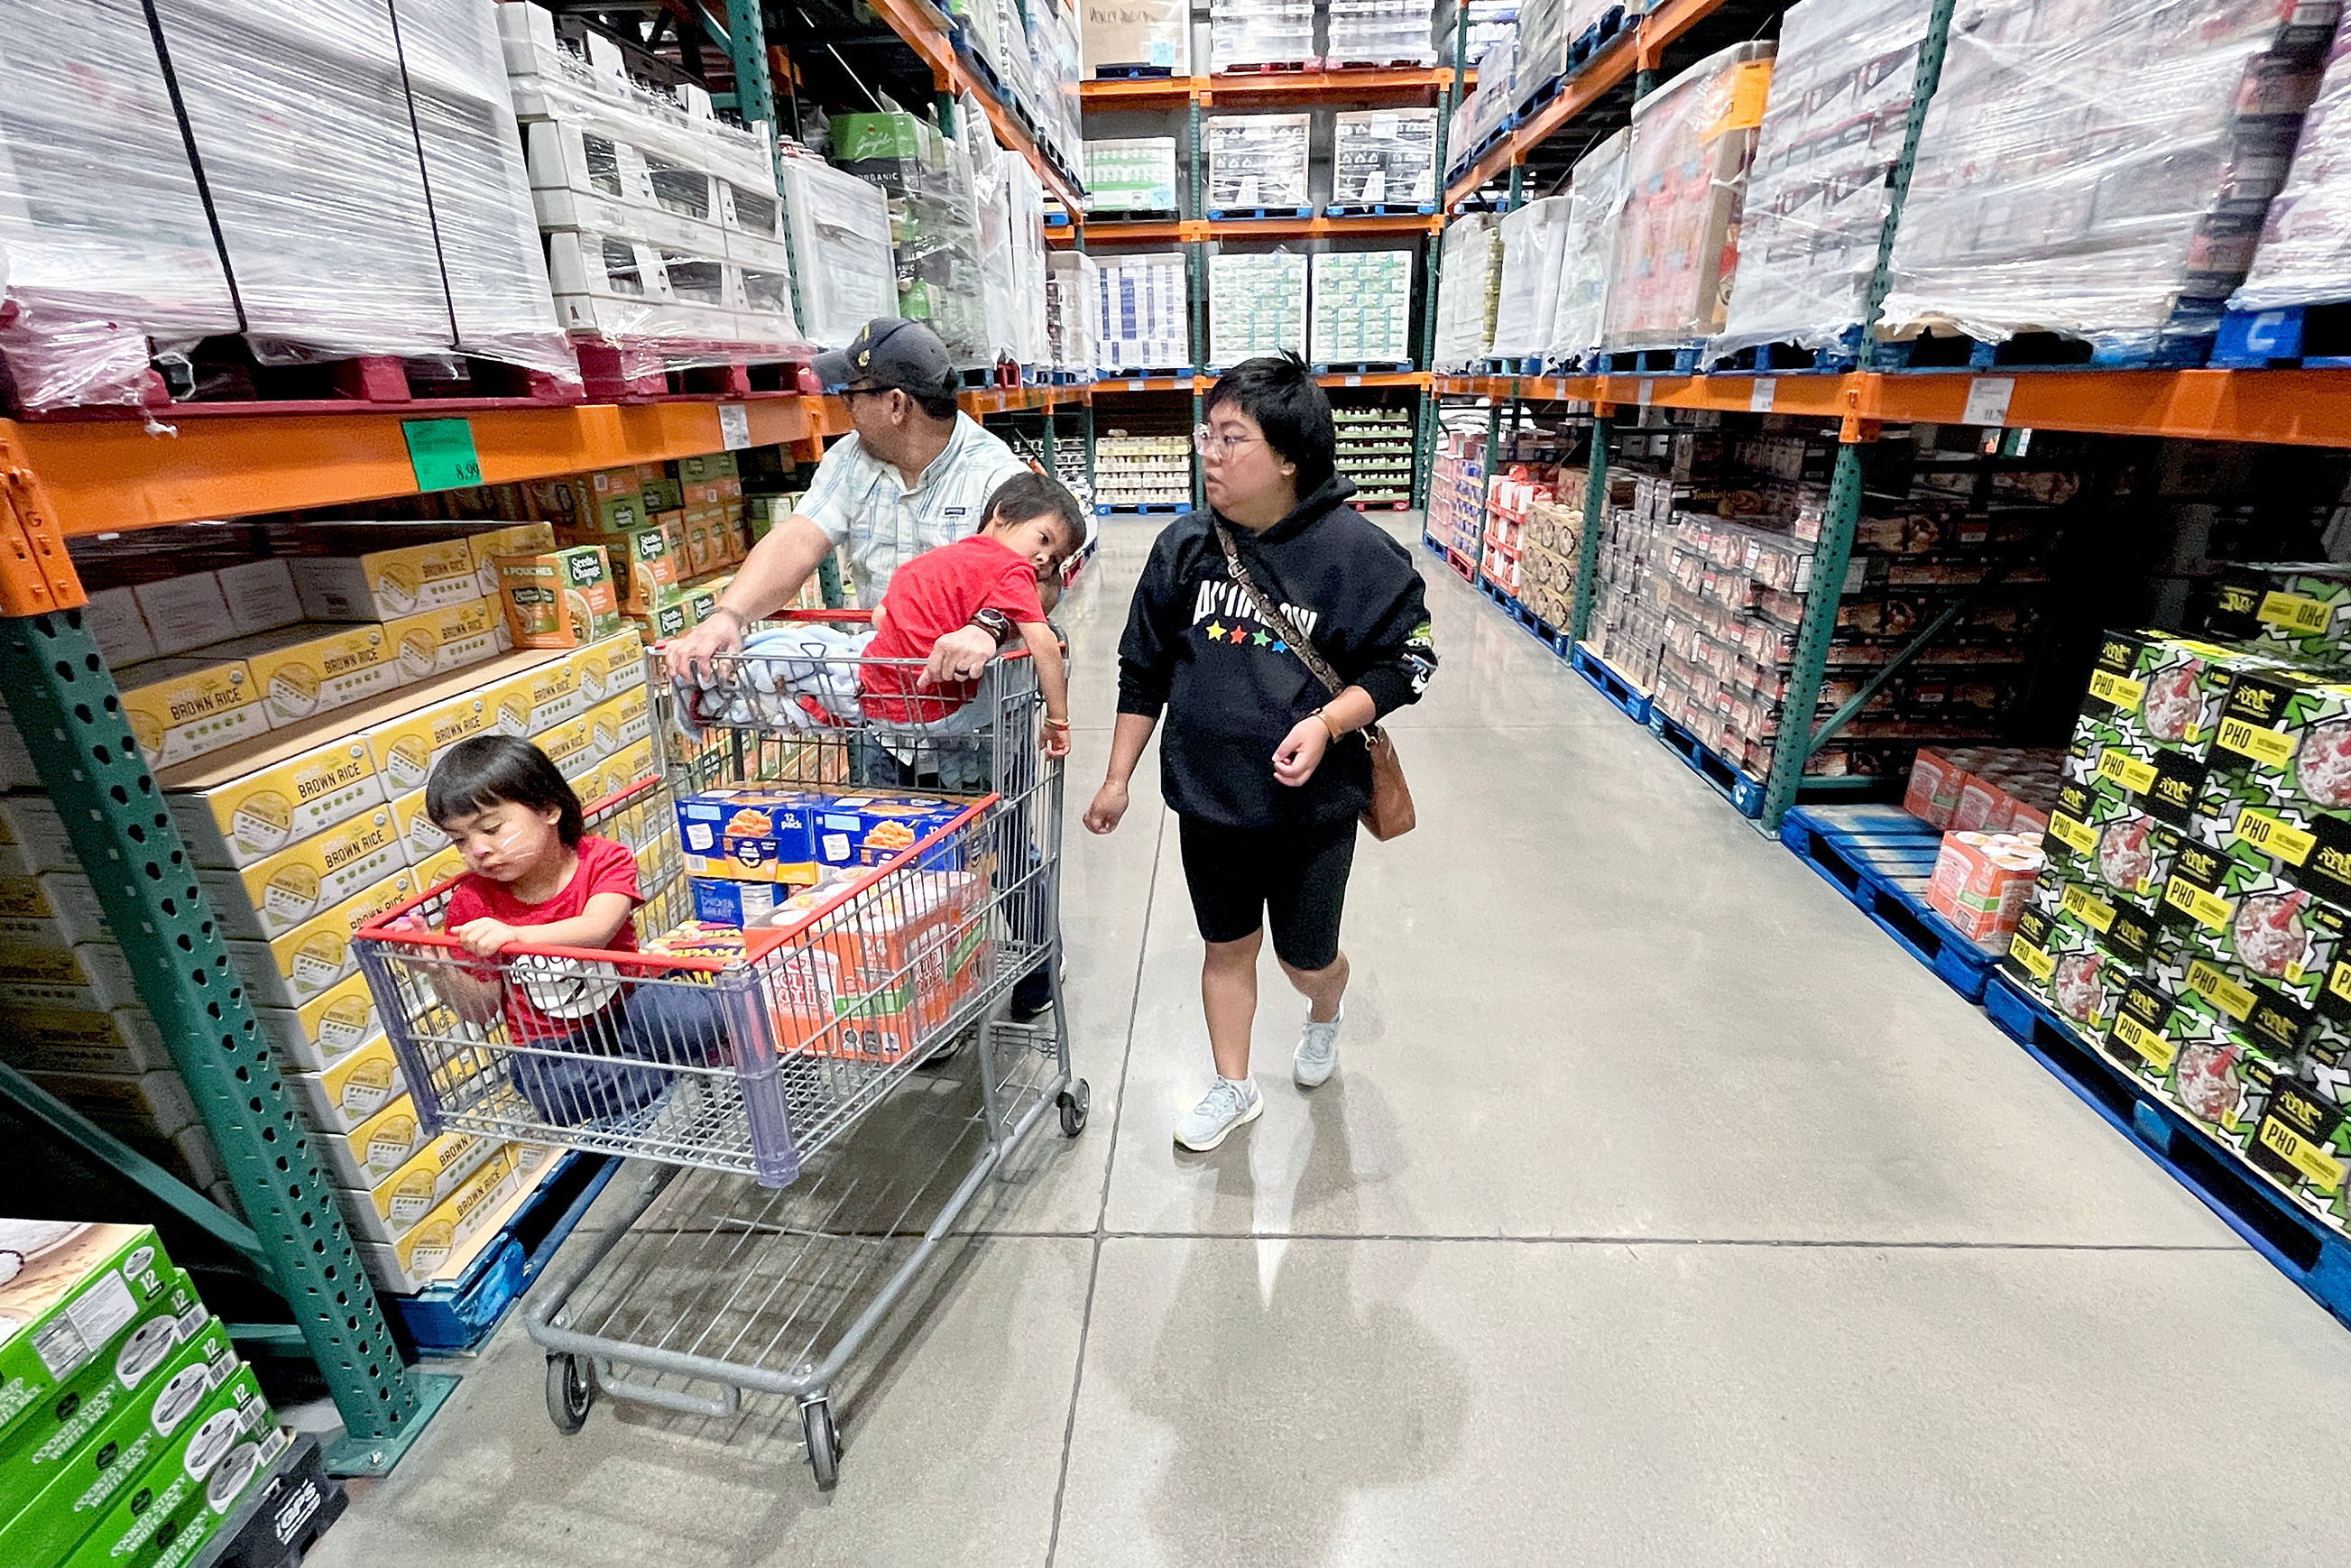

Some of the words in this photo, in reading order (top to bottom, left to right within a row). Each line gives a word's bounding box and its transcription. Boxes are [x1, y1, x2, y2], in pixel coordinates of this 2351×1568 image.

[456, 462, 480, 481] 8.99
[510, 567, 554, 576] POUCHES
[572, 555, 592, 568] Seeds
[573, 566, 601, 580] Change
[324, 654, 356, 674] BROWN
[358, 647, 379, 664] RICE
[2093, 674, 2115, 696] PHO
[171, 696, 214, 720] BROWN
[216, 687, 243, 707] RICE
[434, 721, 462, 743] BROWN
[463, 715, 481, 732] RICE
[2222, 723, 2253, 749] PHO
[2103, 753, 2125, 778] PHO
[297, 772, 337, 798] BROWN
[337, 762, 362, 782] RICE
[780, 820, 803, 830] pack
[784, 814, 795, 822] 12
[2052, 815, 2072, 838] PHO
[2240, 815, 2271, 843] PHO
[325, 840, 362, 869] BROWN
[362, 829, 384, 849] RICE
[2065, 889, 2087, 913] PHO
[2169, 881, 2196, 909] PHO
[2013, 938, 2031, 961] PHO
[2190, 967, 2217, 995] PHO
[2118, 1018, 2143, 1045] PHO
[2265, 1122, 2298, 1156] PHO
[438, 1137, 468, 1167] BROWN
[456, 1185, 485, 1217] BROWN
[484, 1170, 502, 1191] RICE
[139, 1269, 161, 1294] 12
[170, 1288, 190, 1311] 12
[202, 1337, 221, 1359] 12
[232, 1382, 249, 1404] 12
